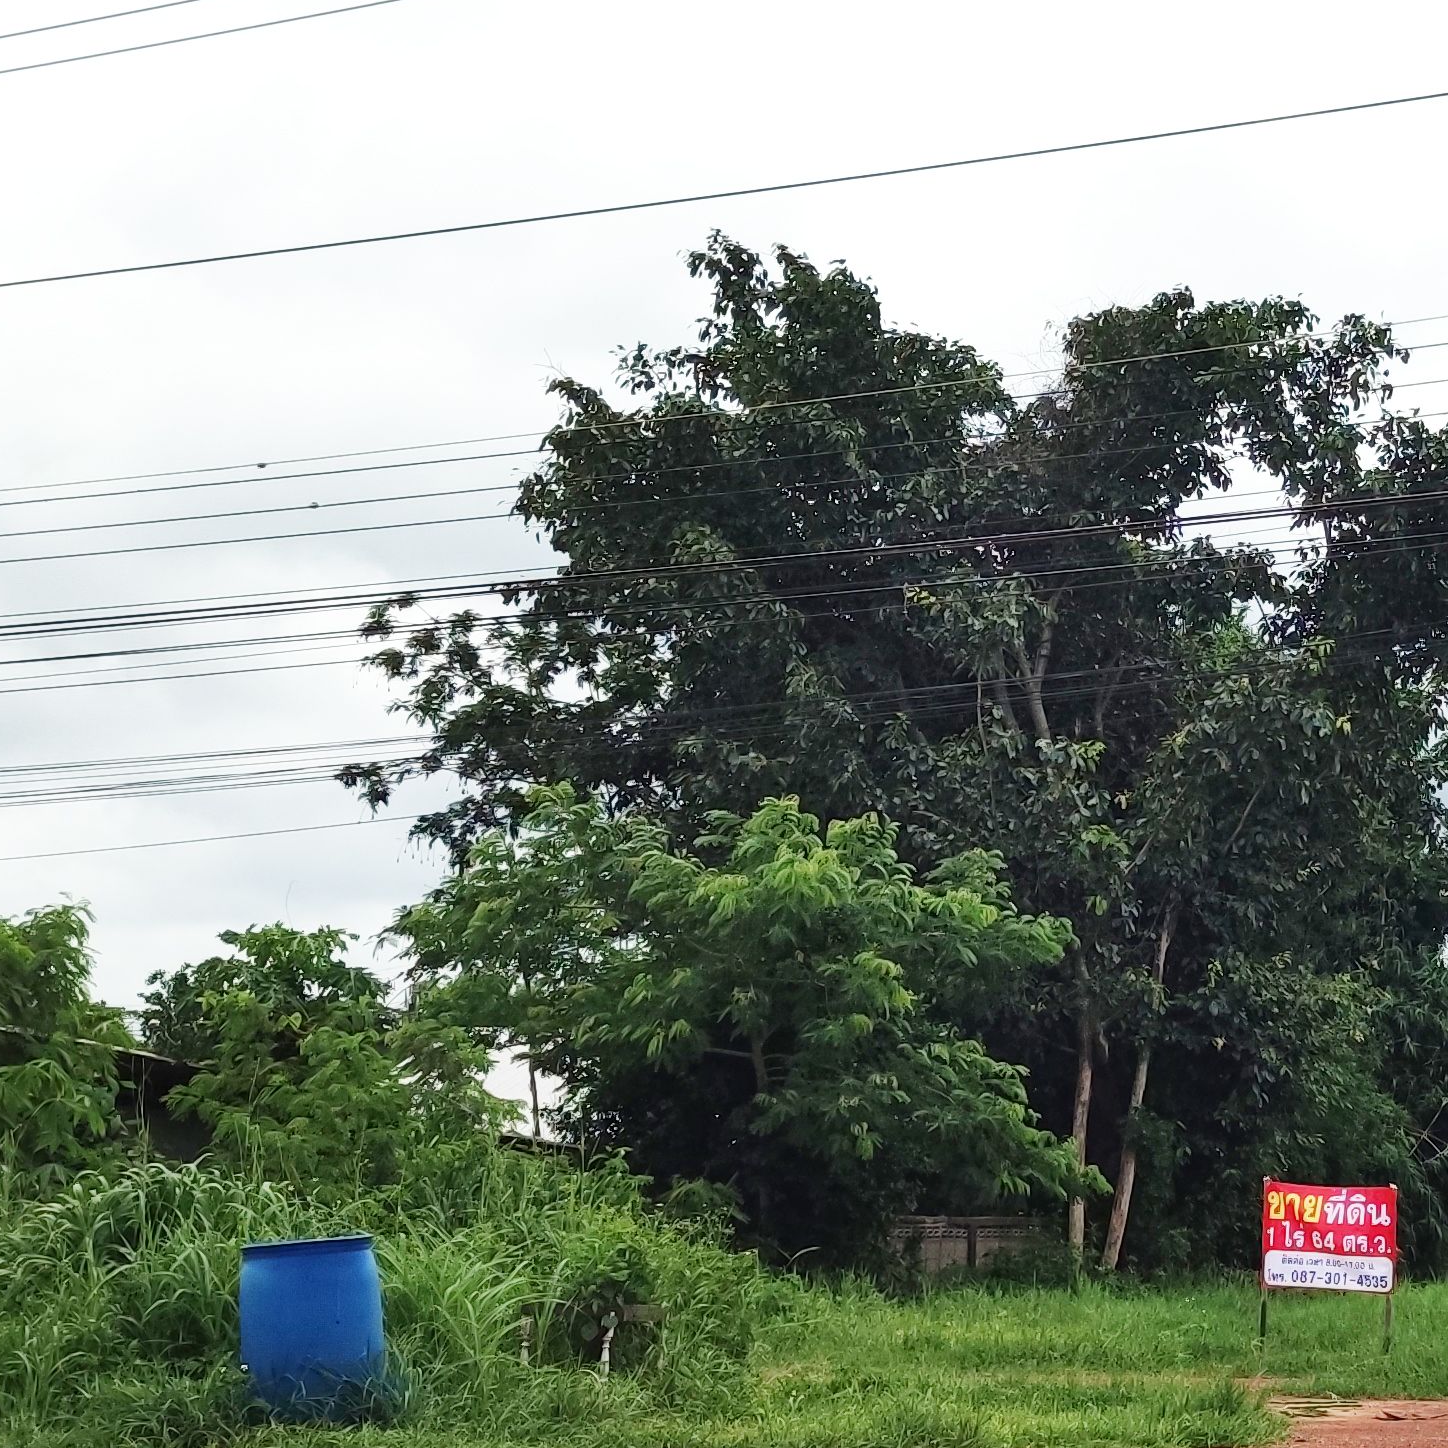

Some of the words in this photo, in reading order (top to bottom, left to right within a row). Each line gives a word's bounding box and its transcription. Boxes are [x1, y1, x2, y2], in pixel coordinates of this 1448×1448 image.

[1267, 1189, 1392, 1227] ขายที่ดิน
[1266, 1226, 1275, 1246] 1
[1281, 1221, 1305, 1248] ไร่
[1311, 1231, 1336, 1251] 64
[1342, 1234, 1392, 1254] ตร.ว.
[1267, 1269, 1287, 1283] โทร.
[1291, 1269, 1388, 1289] 087-301-4535
